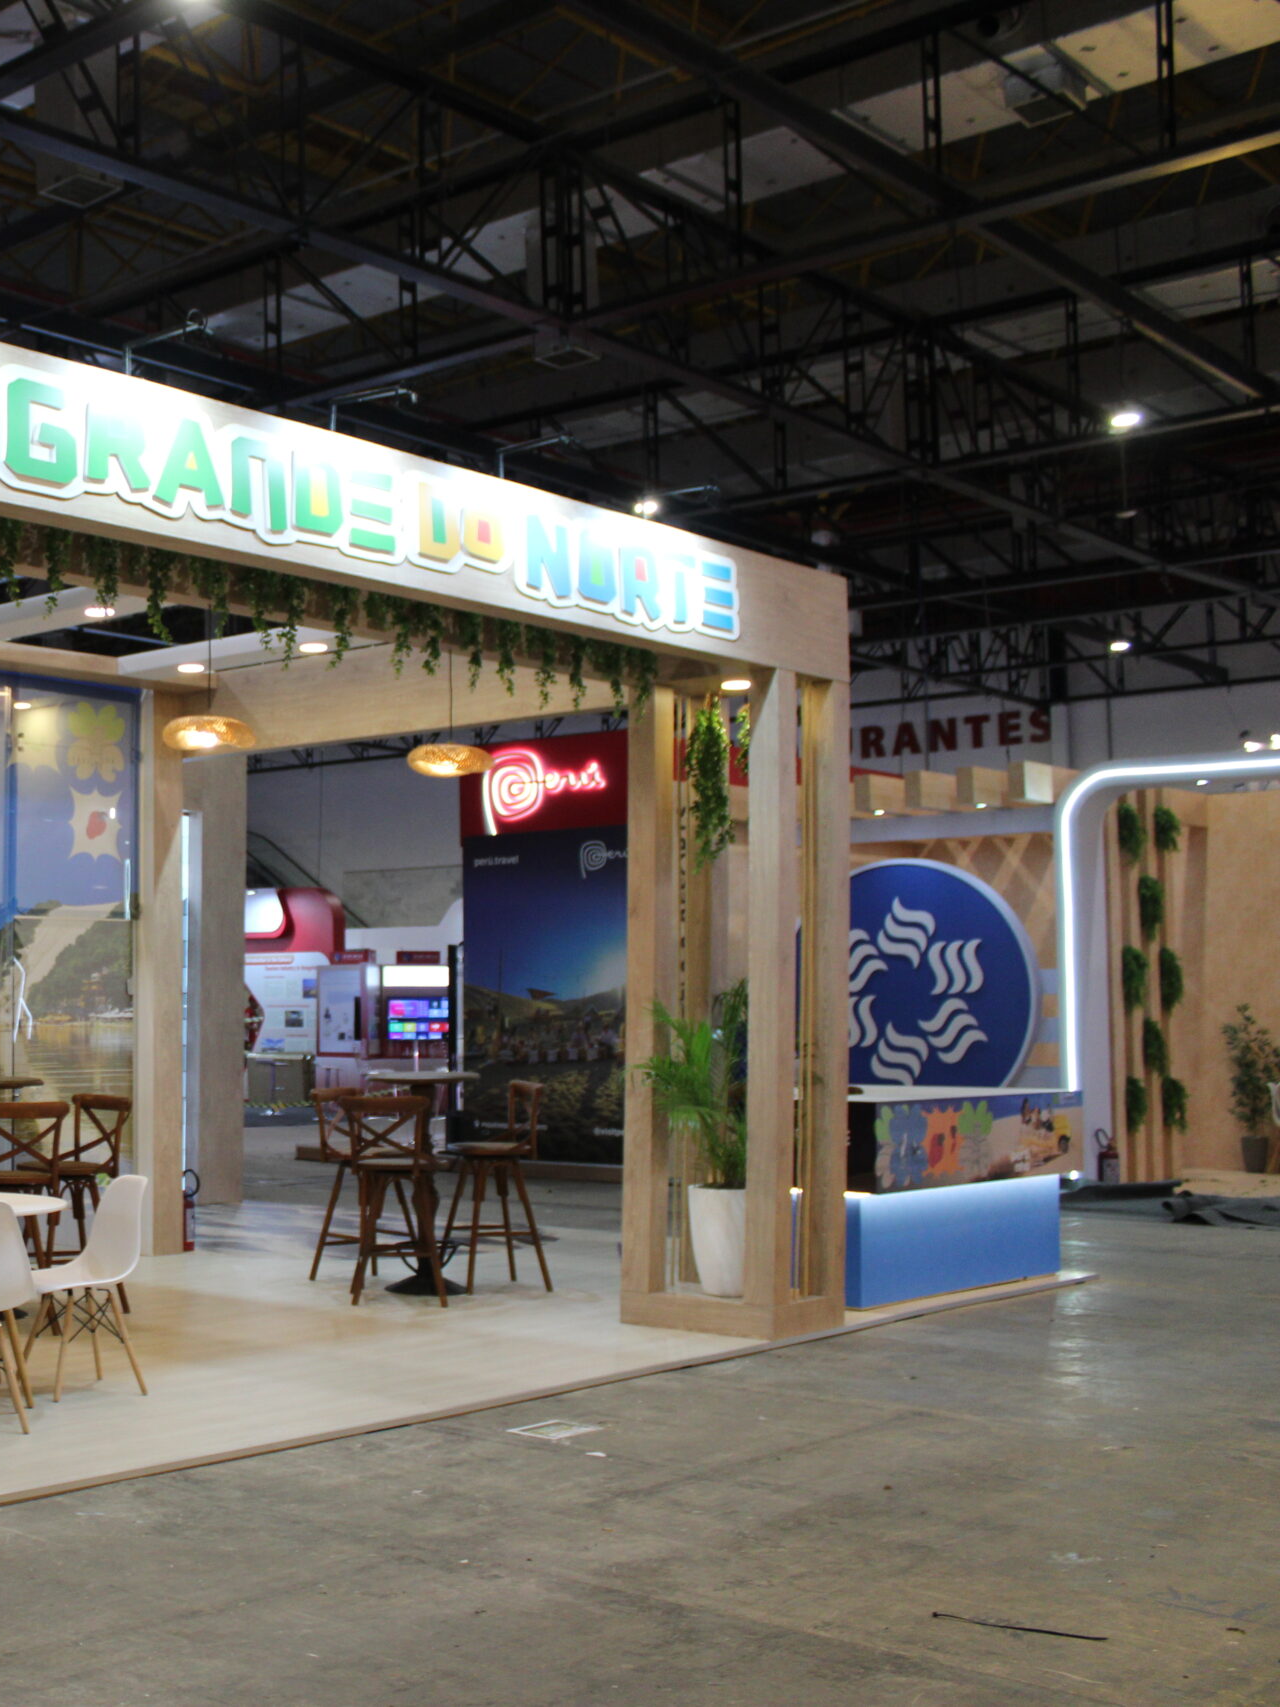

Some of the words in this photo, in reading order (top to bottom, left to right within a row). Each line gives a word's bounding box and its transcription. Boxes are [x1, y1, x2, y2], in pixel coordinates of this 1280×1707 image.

[4, 376, 398, 556] GRANDE
[417, 478, 505, 564] DO
[525, 514, 735, 633] NORTE
[849, 708, 1052, 760] RANTES
